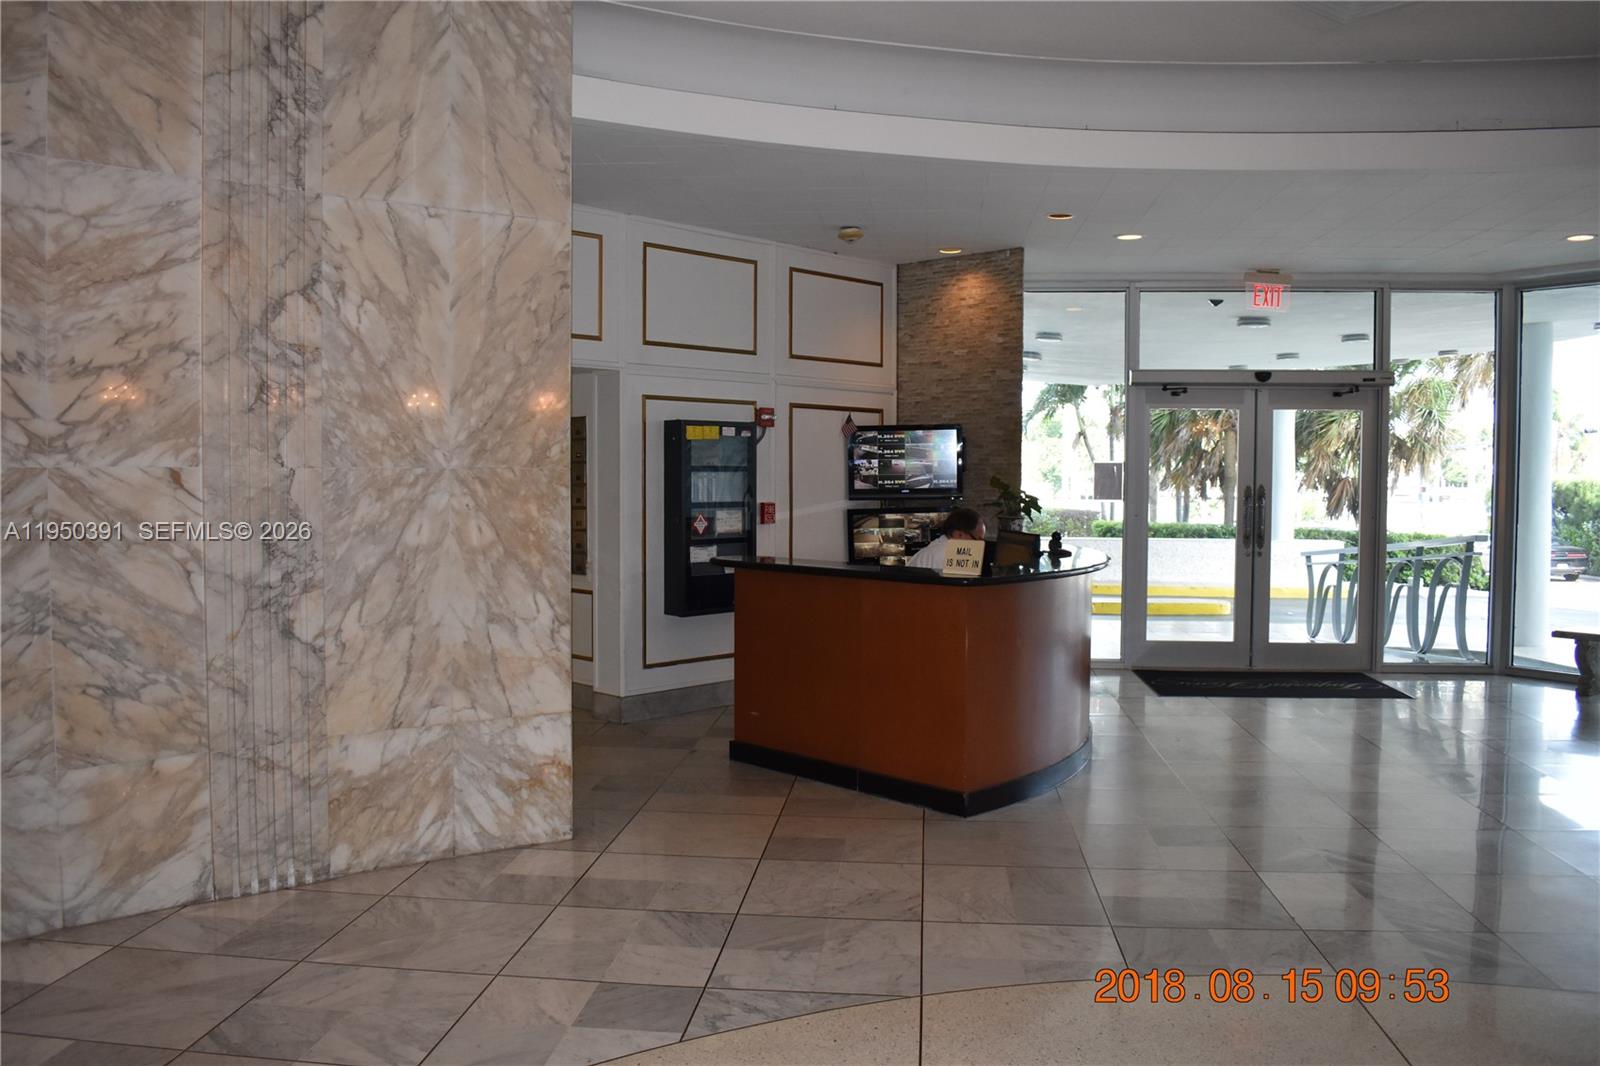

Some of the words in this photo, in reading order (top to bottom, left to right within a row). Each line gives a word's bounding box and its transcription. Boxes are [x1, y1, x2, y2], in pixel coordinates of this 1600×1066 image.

[1253, 284, 1283, 307] EXIT
[956, 547, 973, 556] MAIL
[946, 558, 954, 568] IS
[956, 558, 970, 568] NOT
[972, 560, 980, 569] IN
